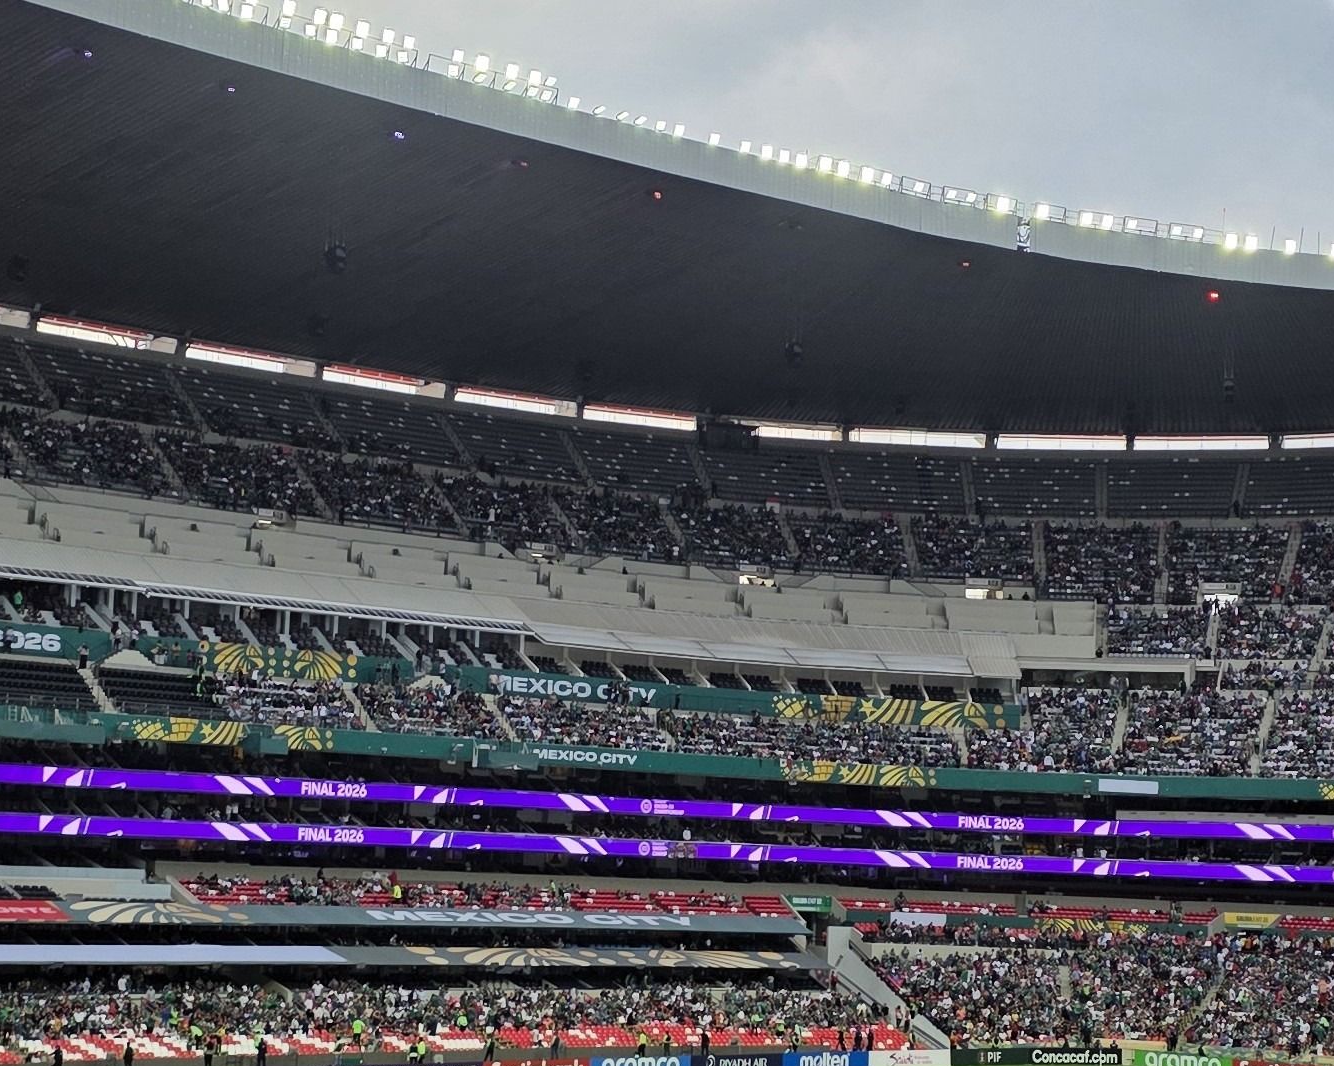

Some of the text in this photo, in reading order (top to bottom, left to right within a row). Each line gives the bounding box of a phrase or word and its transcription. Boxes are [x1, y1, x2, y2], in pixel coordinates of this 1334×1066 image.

[597, 684, 657, 702] CTY
[533, 748, 638, 766] MEXICO CITY
[301, 781, 368, 798] FINAL 2026
[958, 815, 1025, 831] FINAL 2026
[298, 826, 365, 844] FINAL 2026
[956, 855, 1024, 870] FINAL 2026
[367, 909, 692, 927] MEXICO CITY
[987, 1051, 1002, 1063] PIF
[1032, 1050, 1118, 1066] Concacaf.com
